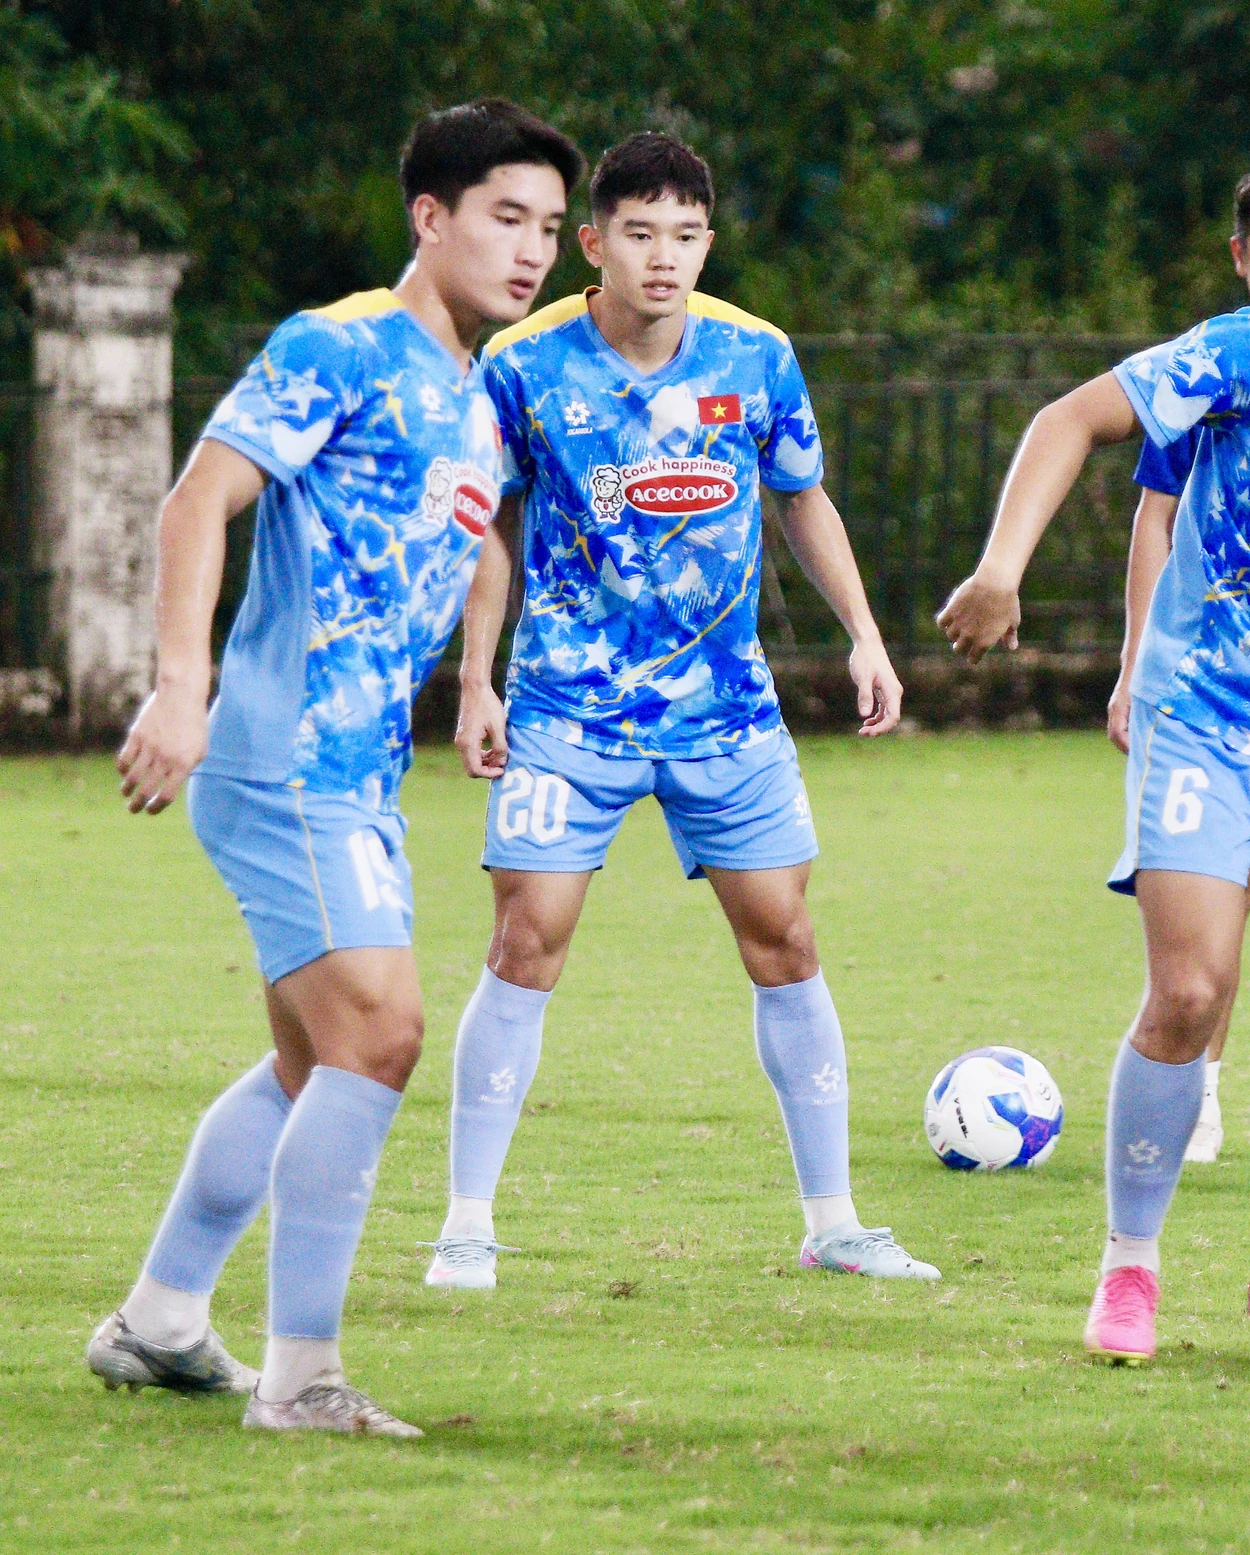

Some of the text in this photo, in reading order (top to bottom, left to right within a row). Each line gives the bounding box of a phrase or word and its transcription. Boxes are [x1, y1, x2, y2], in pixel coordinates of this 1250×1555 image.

[622, 457, 735, 480] Cook happiness
[496, 766, 571, 844] 20
[1161, 767, 1210, 836] 6
